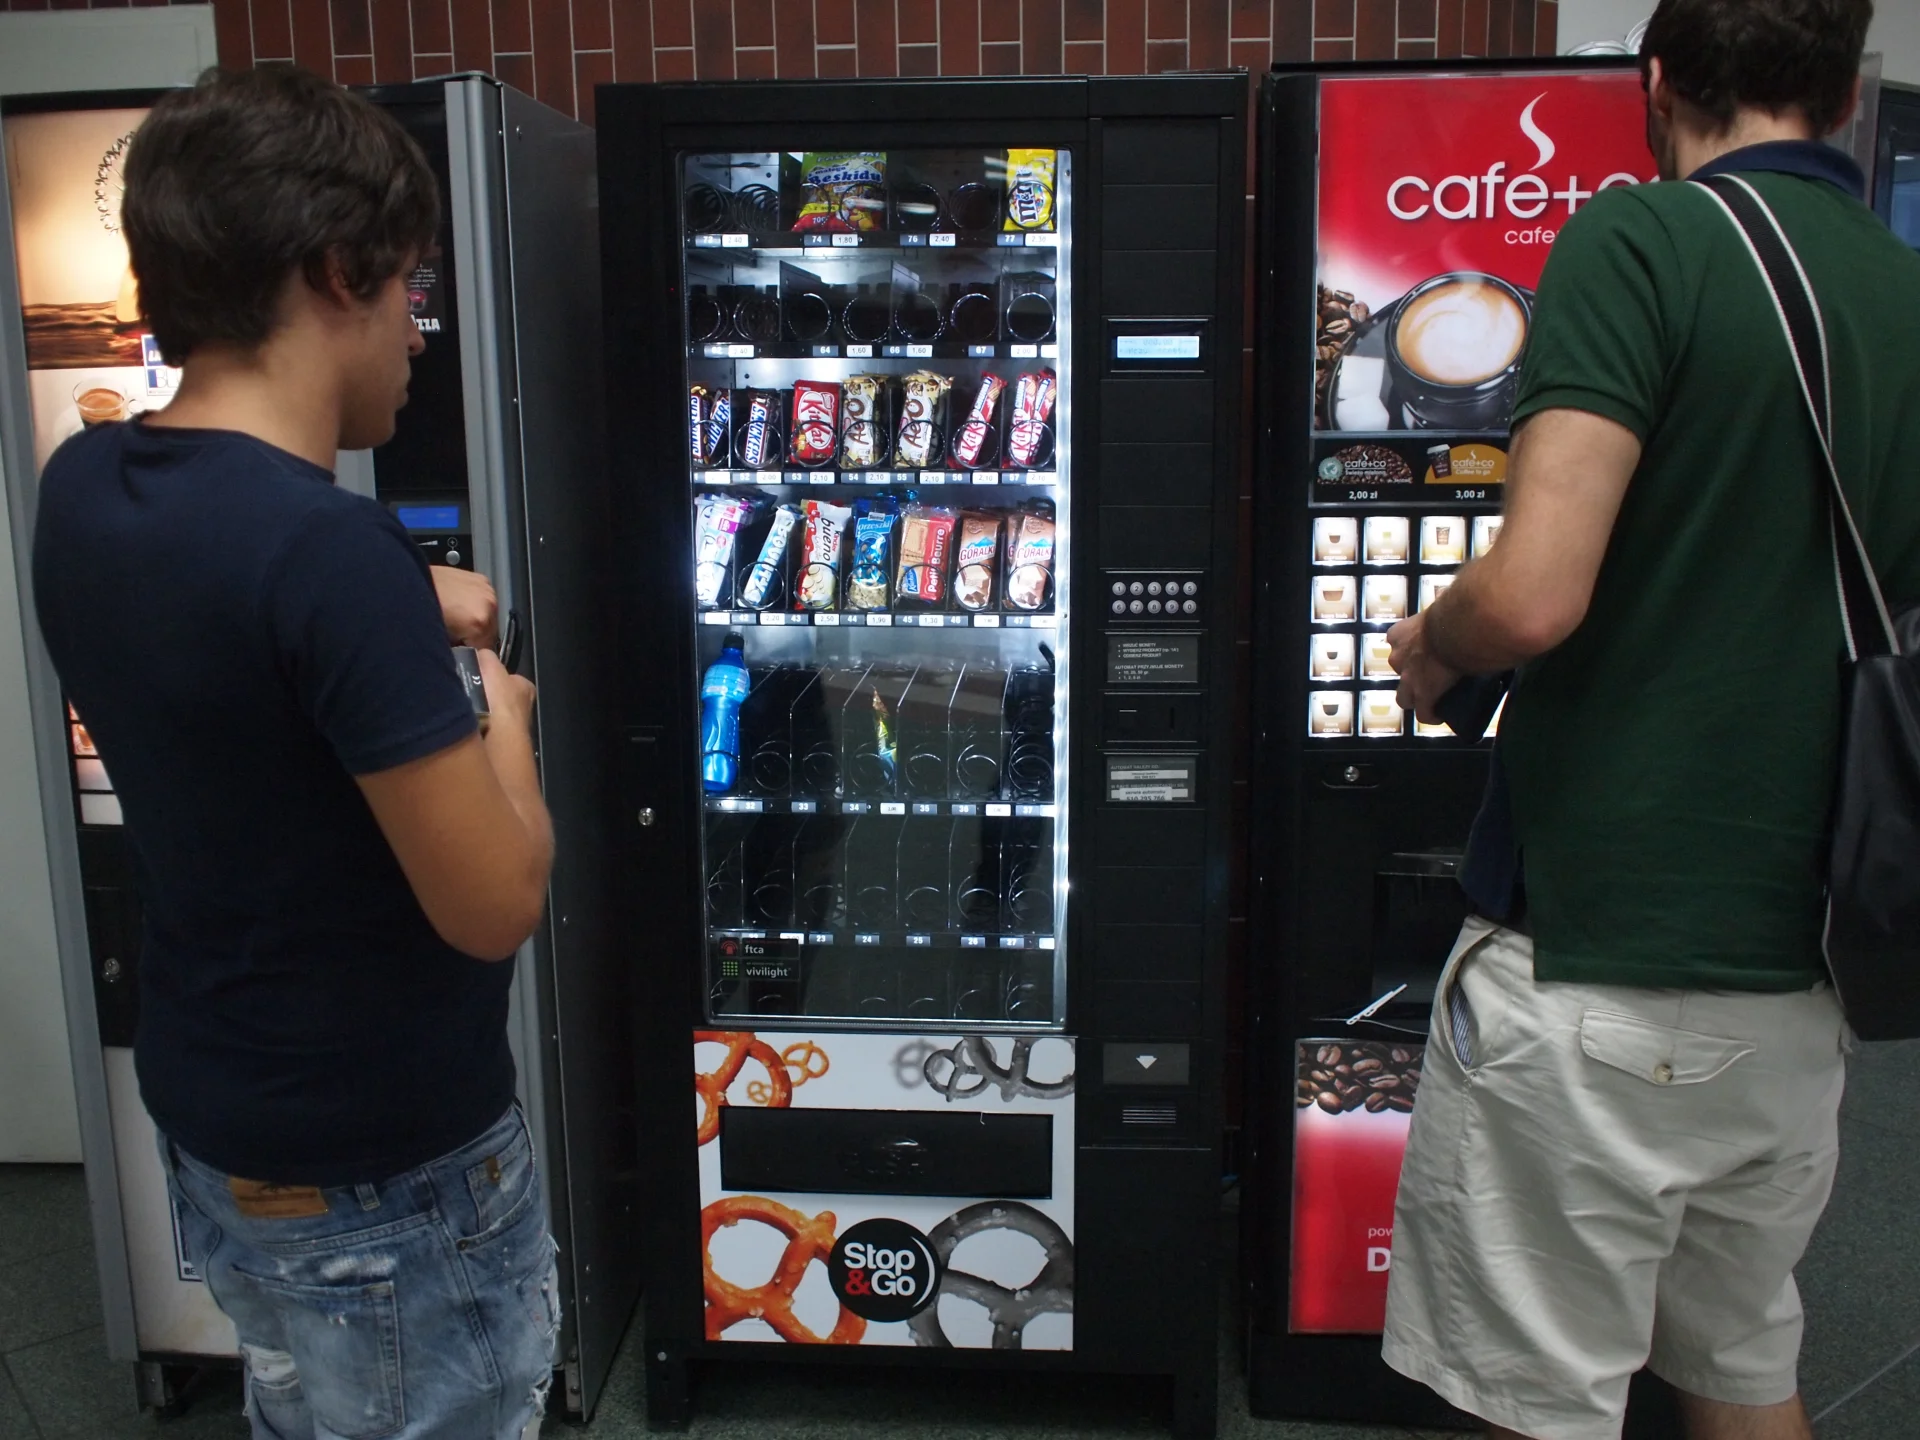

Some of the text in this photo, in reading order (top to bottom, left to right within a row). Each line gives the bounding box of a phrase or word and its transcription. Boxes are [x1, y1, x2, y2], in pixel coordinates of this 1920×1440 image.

[808, 170, 882, 185] Beskidu
[907, 235, 918, 243] 76
[820, 346, 831, 354] 64
[889, 346, 900, 354] 66
[848, 473, 859, 481] 54
[897, 473, 907, 481] 55
[952, 473, 963, 481] 56
[820, 517, 836, 562] bueno
[931, 528, 946, 565] Beurre
[902, 615, 913, 623] 45
[1014, 616, 1024, 624] 47
[798, 803, 809, 811] 33
[849, 803, 859, 811] 34
[919, 804, 930, 812] 35
[816, 934, 826, 942] 23
[913, 936, 923, 944] 25
[968, 937, 978, 945] 26
[1006, 937, 1017, 946] 27
[744, 944, 764, 954] ftca
[746, 966, 788, 978] vivilight
[844, 1242, 916, 1277] Stop
